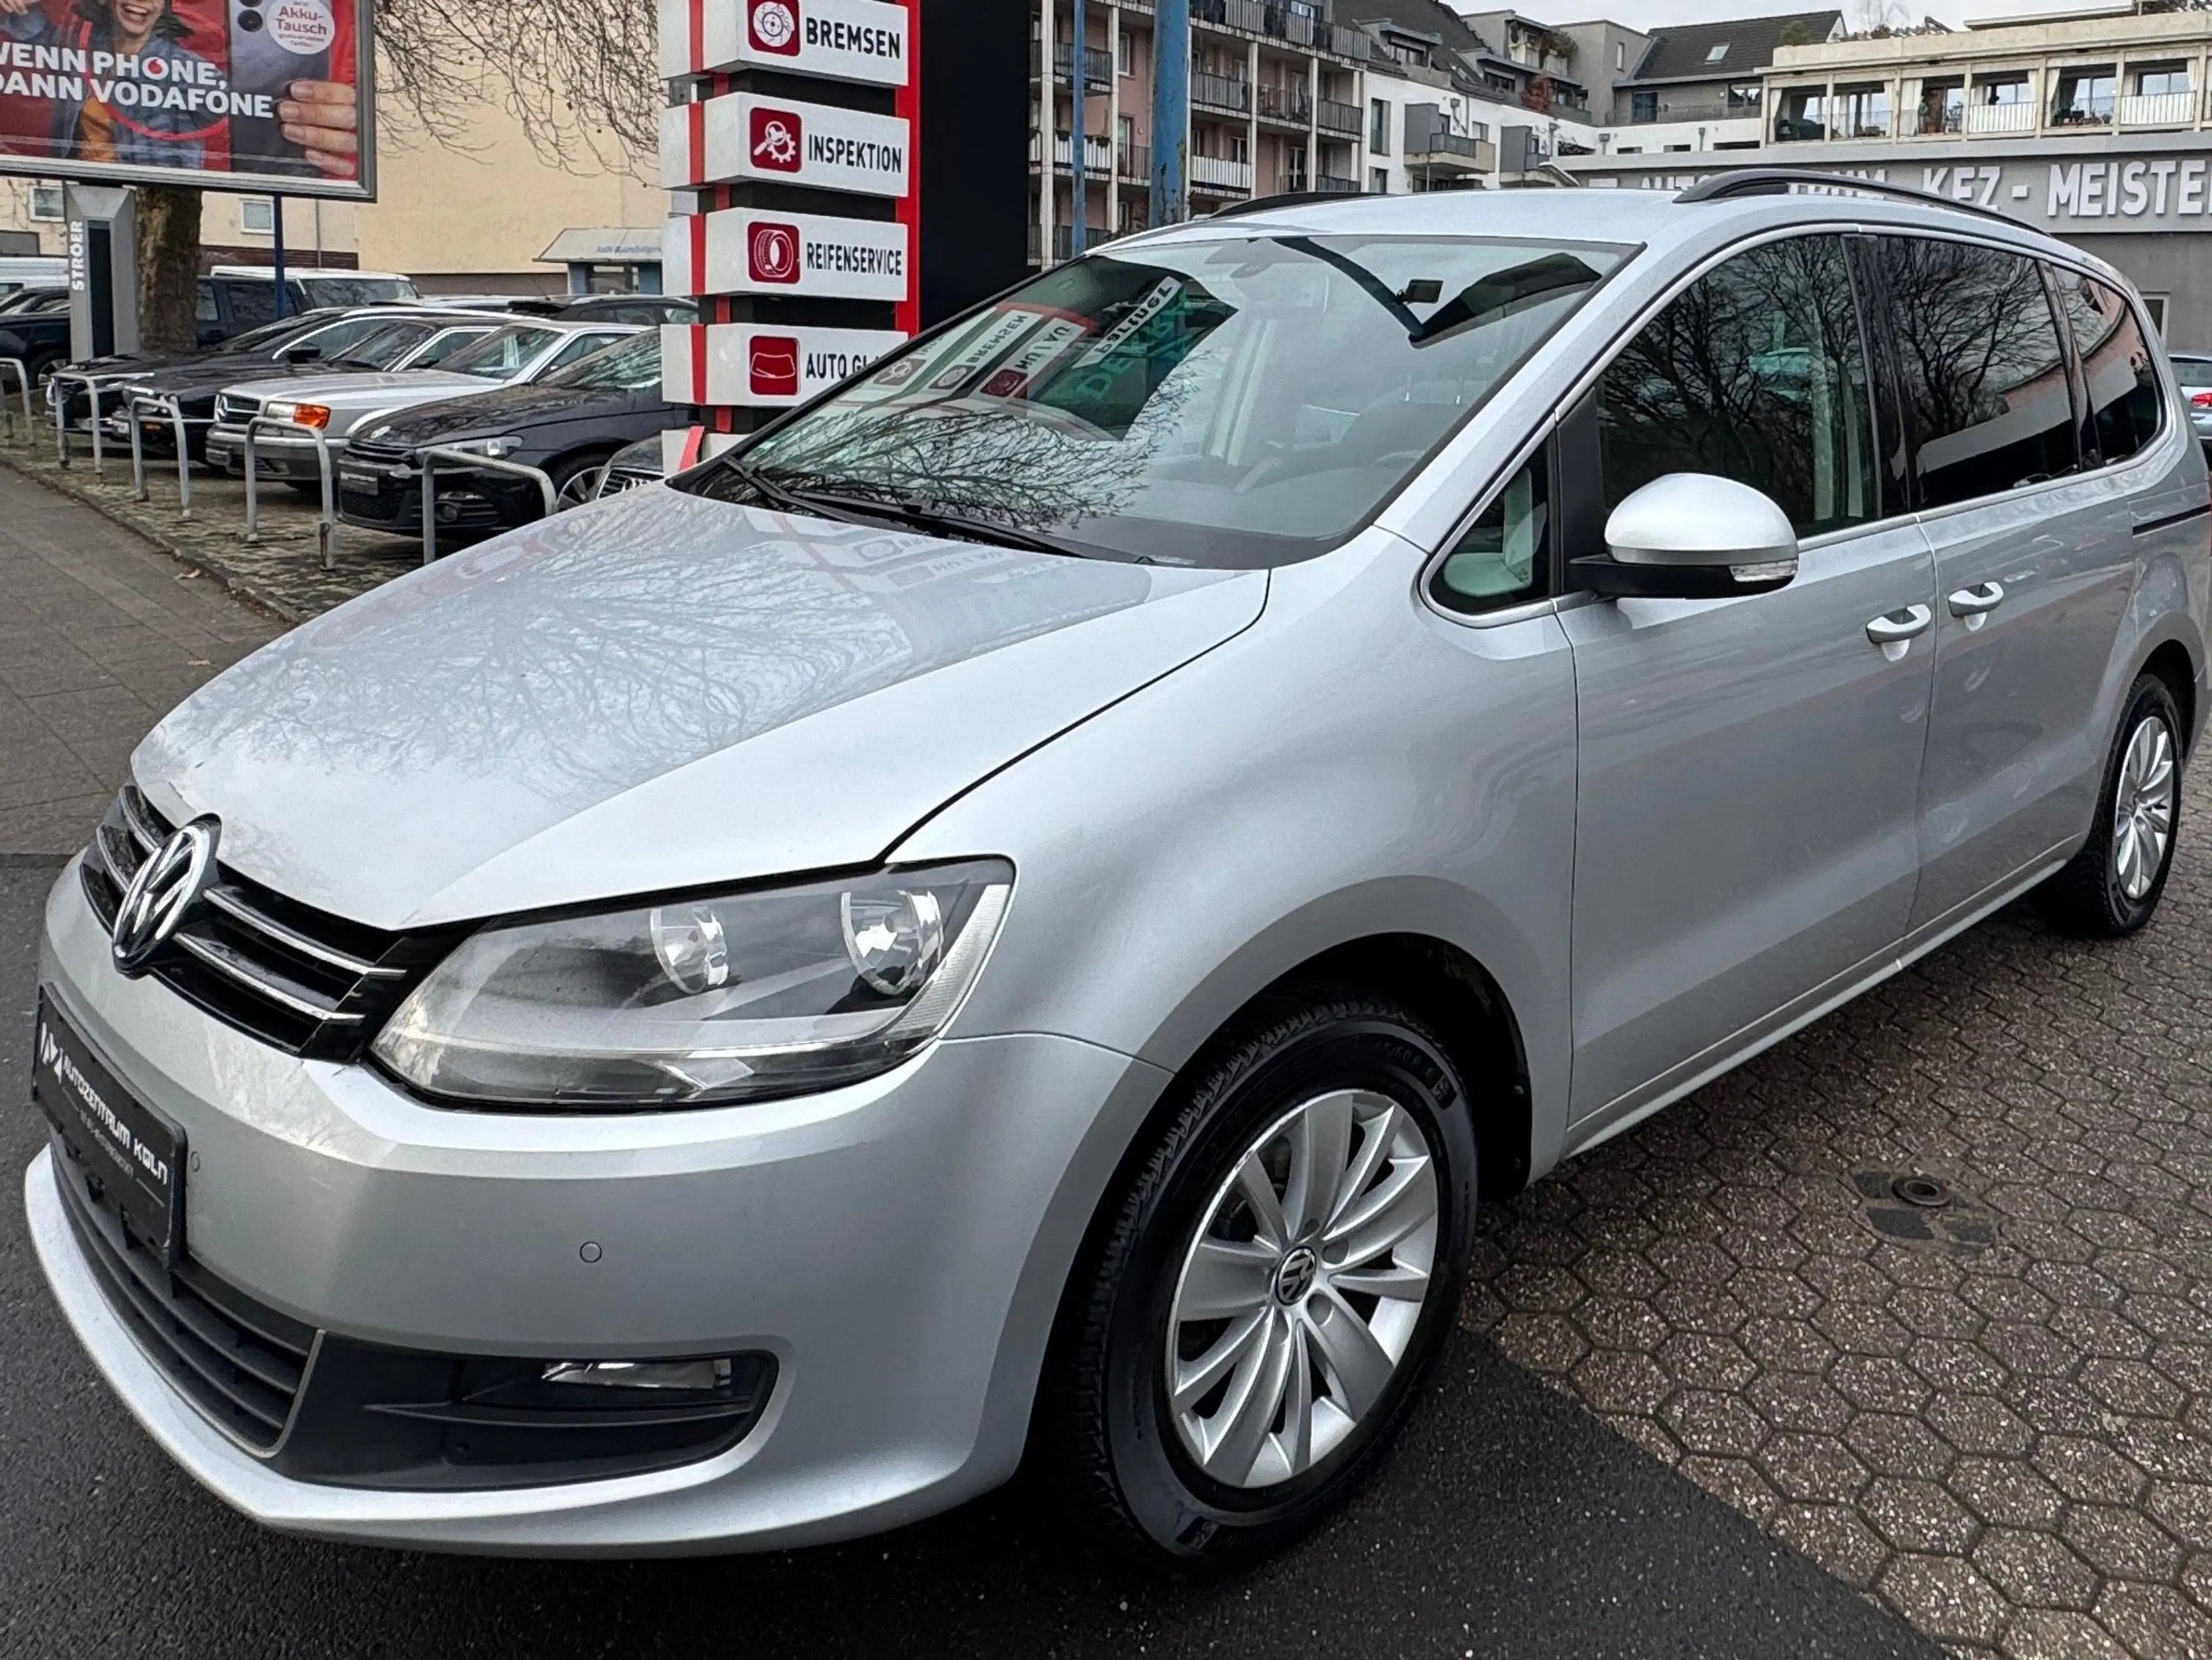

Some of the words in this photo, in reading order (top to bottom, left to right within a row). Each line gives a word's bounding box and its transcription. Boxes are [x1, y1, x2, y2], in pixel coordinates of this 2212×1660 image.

[275, 18, 327, 35] Tausch
[278, 6, 324, 21] Akku-
[805, 17, 900, 59] BREMSEN
[93, 51, 228, 90] PHONE,
[0, 71, 82, 101] ANN
[90, 78, 274, 119] VODAFONE
[808, 133, 902, 173] INSPEKTION
[2047, 160, 2212, 216] MEISTE
[806, 242, 902, 277] REIFENSERVICE
[806, 352, 847, 379] AUTO
